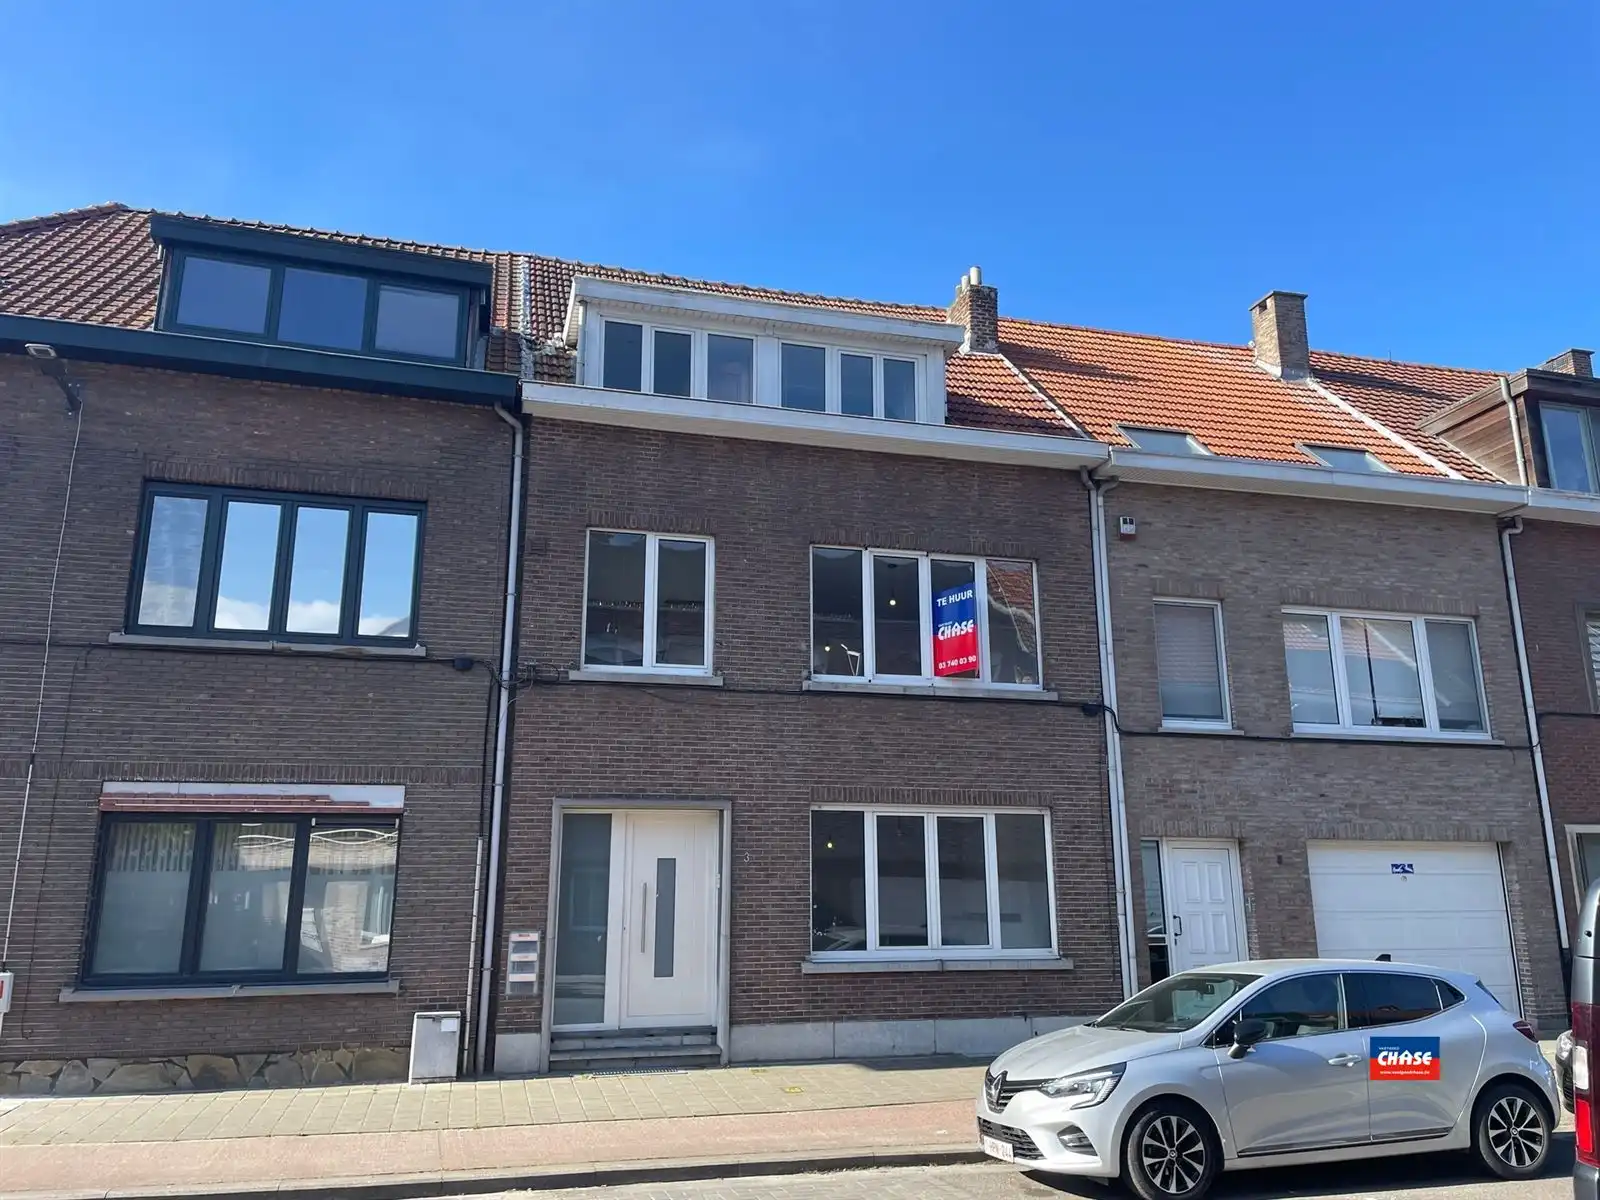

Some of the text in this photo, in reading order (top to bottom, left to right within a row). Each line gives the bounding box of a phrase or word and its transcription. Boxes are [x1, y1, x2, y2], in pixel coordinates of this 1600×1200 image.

[937, 590, 973, 607] TE HUUR
[938, 619, 975, 641] CHASE
[938, 661, 946, 669] 03
[947, 659, 959, 668] 740
[959, 657, 967, 665] 03
[1377, 1049, 1433, 1066] CHASE
